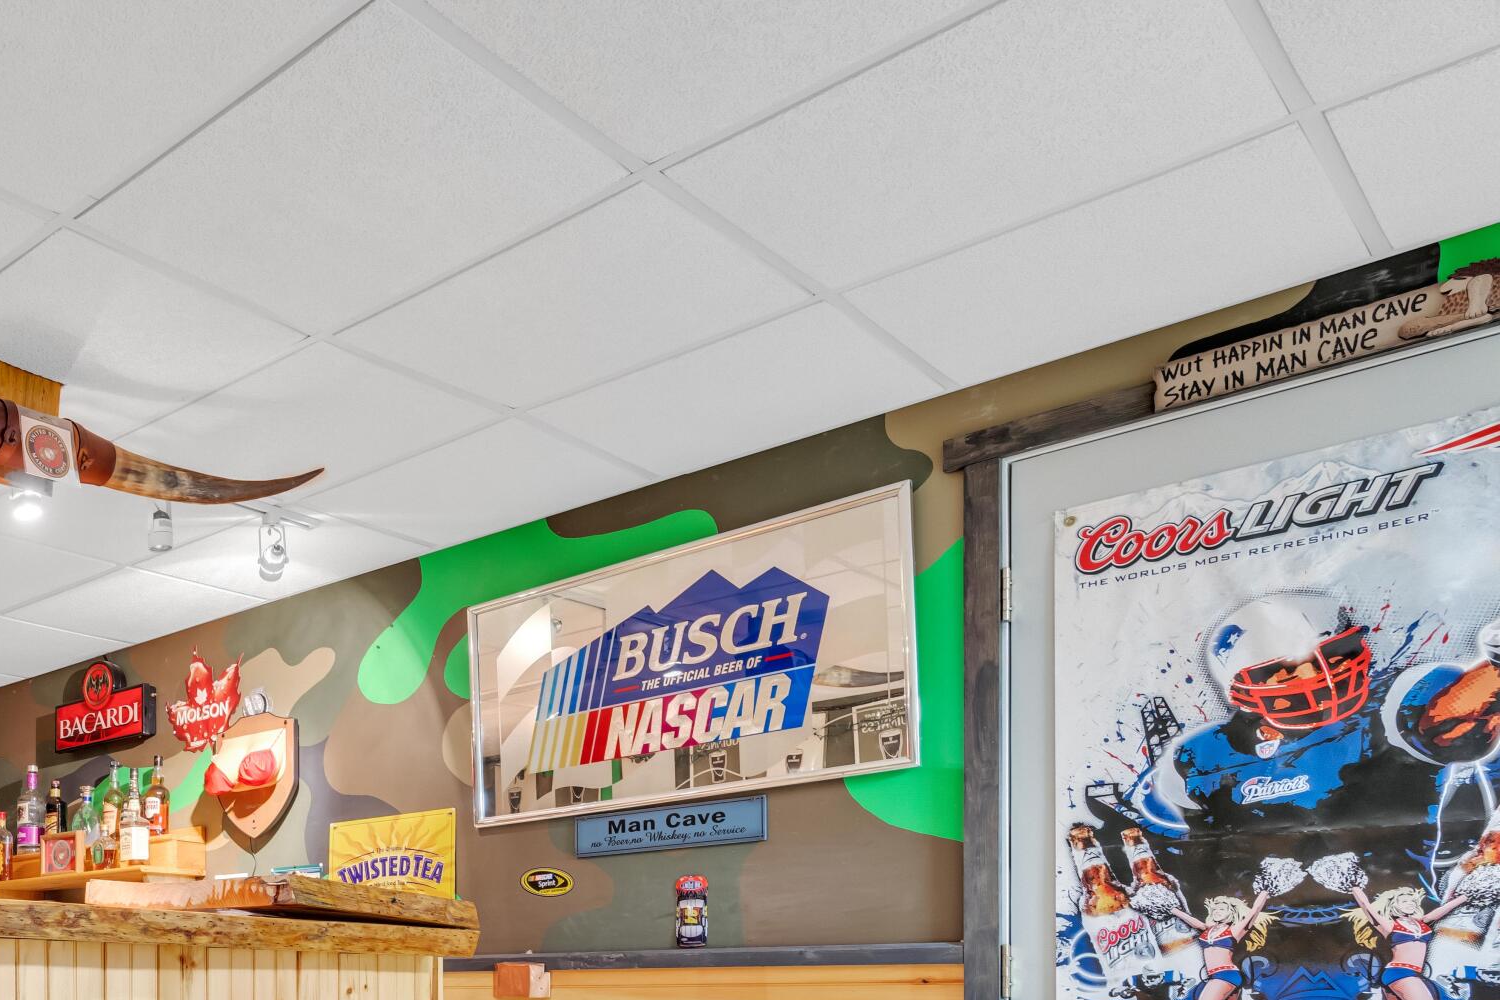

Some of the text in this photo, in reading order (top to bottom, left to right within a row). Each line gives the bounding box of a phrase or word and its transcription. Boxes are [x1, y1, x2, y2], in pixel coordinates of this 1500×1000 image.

[1213, 334, 1283, 369] HAPPIN
[1292, 326, 1311, 346] IN
[1319, 310, 1366, 338] MAN
[1224, 370, 1244, 390] IN
[1255, 349, 1307, 382] MAN
[1075, 461, 1445, 575] Coors LIGHT
[1079, 513, 1430, 590] THE WORLD'S MOST REFRESHING BEER
[612, 591, 808, 682] BUSCH
[641, 655, 763, 691] THE OFFICIAL BEER OF
[59, 702, 140, 740] BACARDI
[176, 701, 230, 727] MOLSON
[604, 672, 792, 761] NASCAR
[1241, 774, 1310, 805] Patriots
[590, 841, 603, 849] no
[694, 830, 706, 838] no
[709, 825, 747, 837] Service
[608, 809, 727, 835] Man Cave
[337, 854, 444, 885] TWISTED TEA
[538, 880, 556, 888] Sprint
[1097, 915, 1145, 953] Coors
